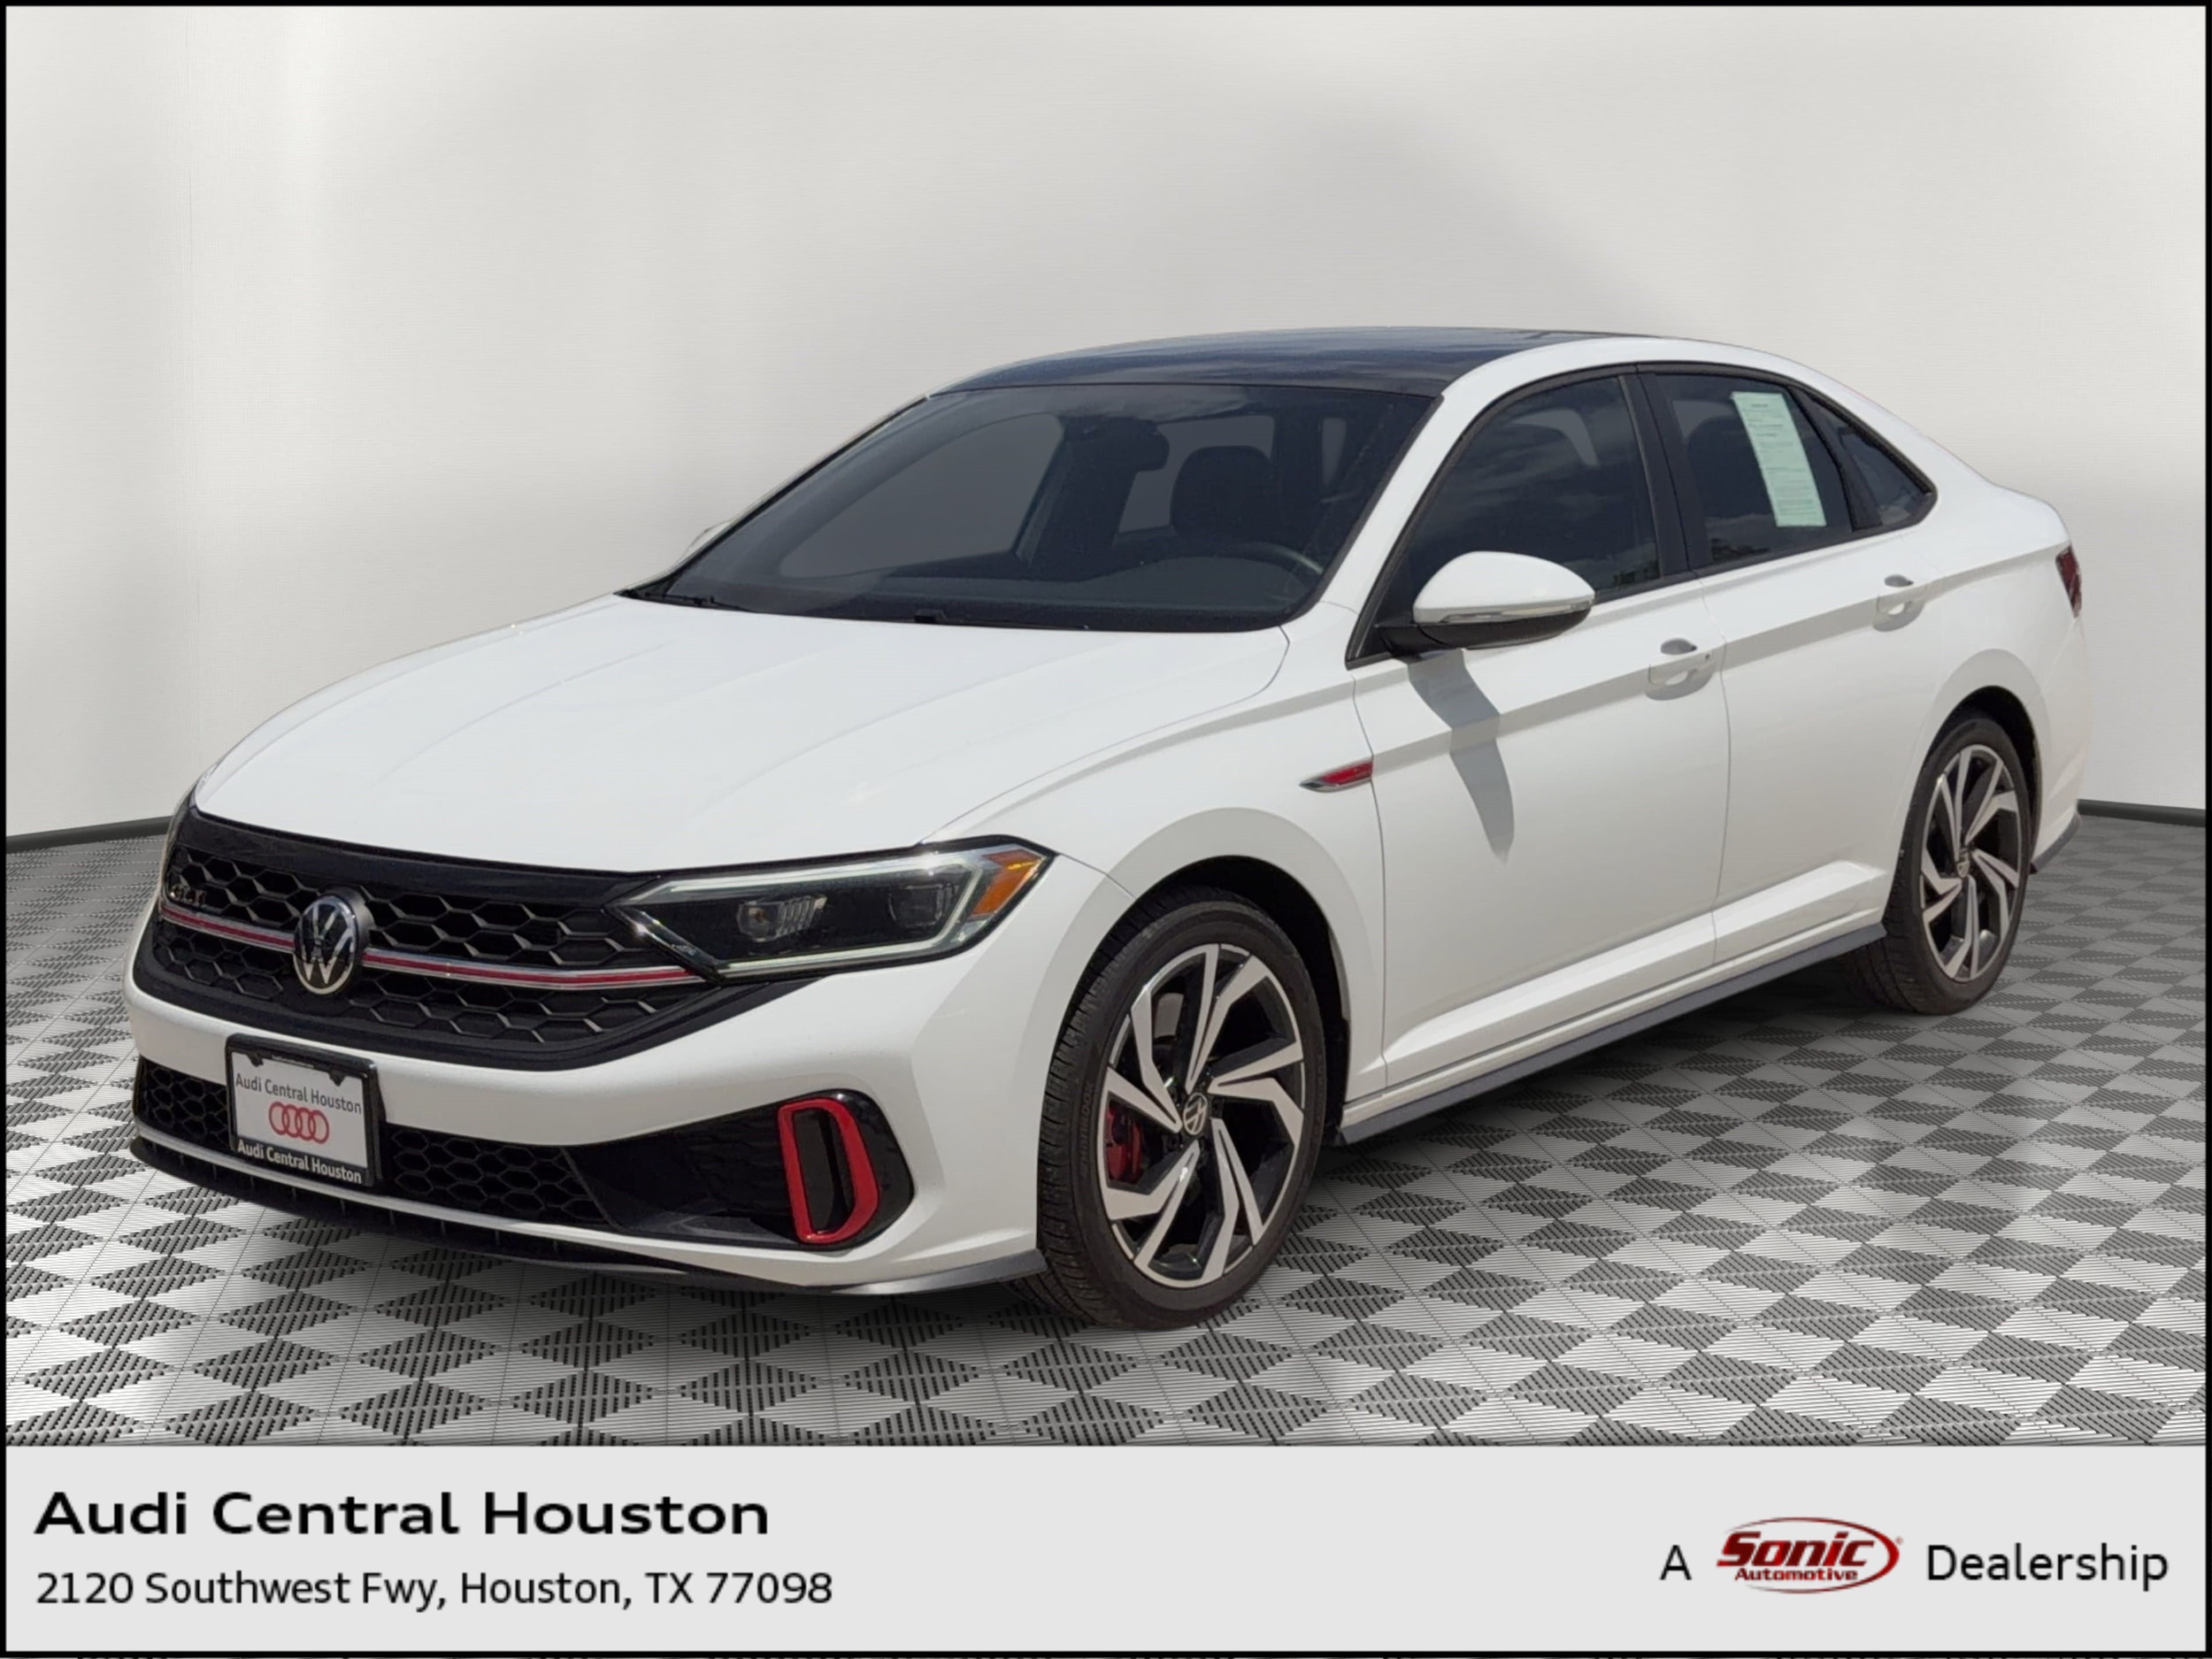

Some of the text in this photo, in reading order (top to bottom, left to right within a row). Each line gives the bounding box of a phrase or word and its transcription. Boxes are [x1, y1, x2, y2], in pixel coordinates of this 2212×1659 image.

[235, 1072, 363, 1115] Audi Central Houston
[237, 1139, 363, 1185] Audi Central Houston
